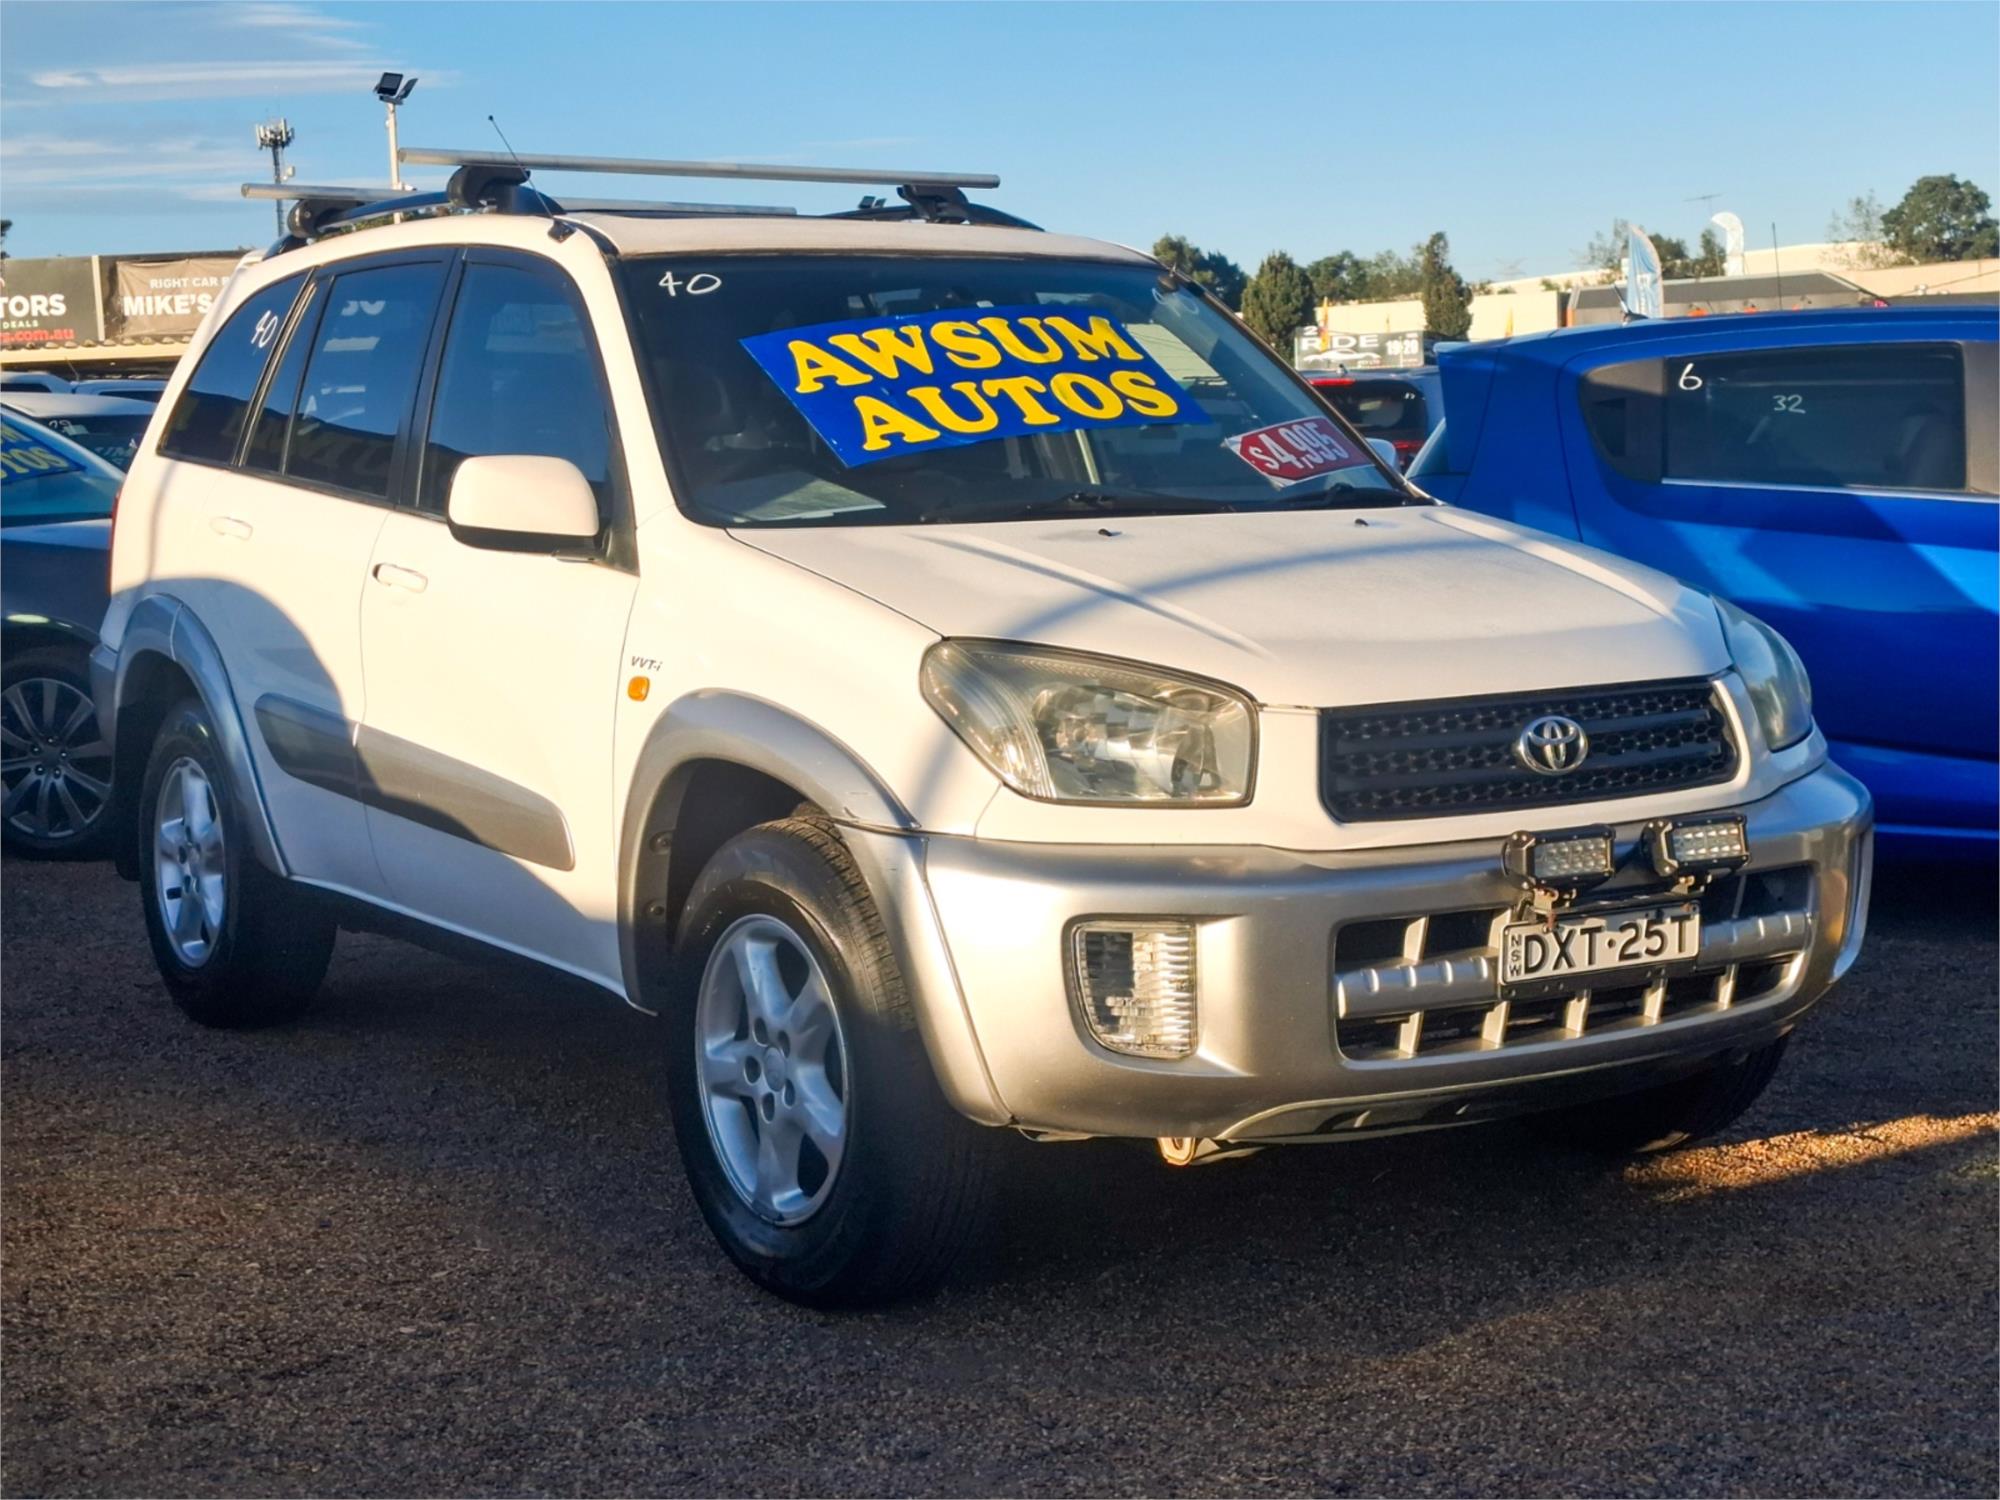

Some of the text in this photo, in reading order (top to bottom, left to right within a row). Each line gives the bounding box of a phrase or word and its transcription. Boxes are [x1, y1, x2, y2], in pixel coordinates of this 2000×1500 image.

[150, 278, 189, 289] RIGHT
[192, 276, 219, 288] CAR
[658, 271, 722, 296] 40
[123, 293, 214, 316] MIKE'S
[2, 320, 39, 329] DEALS
[787, 315, 1145, 394] AWSUM
[1678, 362, 1703, 391] 6
[852, 370, 1179, 451] AUTOS
[1772, 394, 1806, 414] 32
[1249, 422, 1349, 470] $4,995
[1509, 932, 1523, 977] NSW
